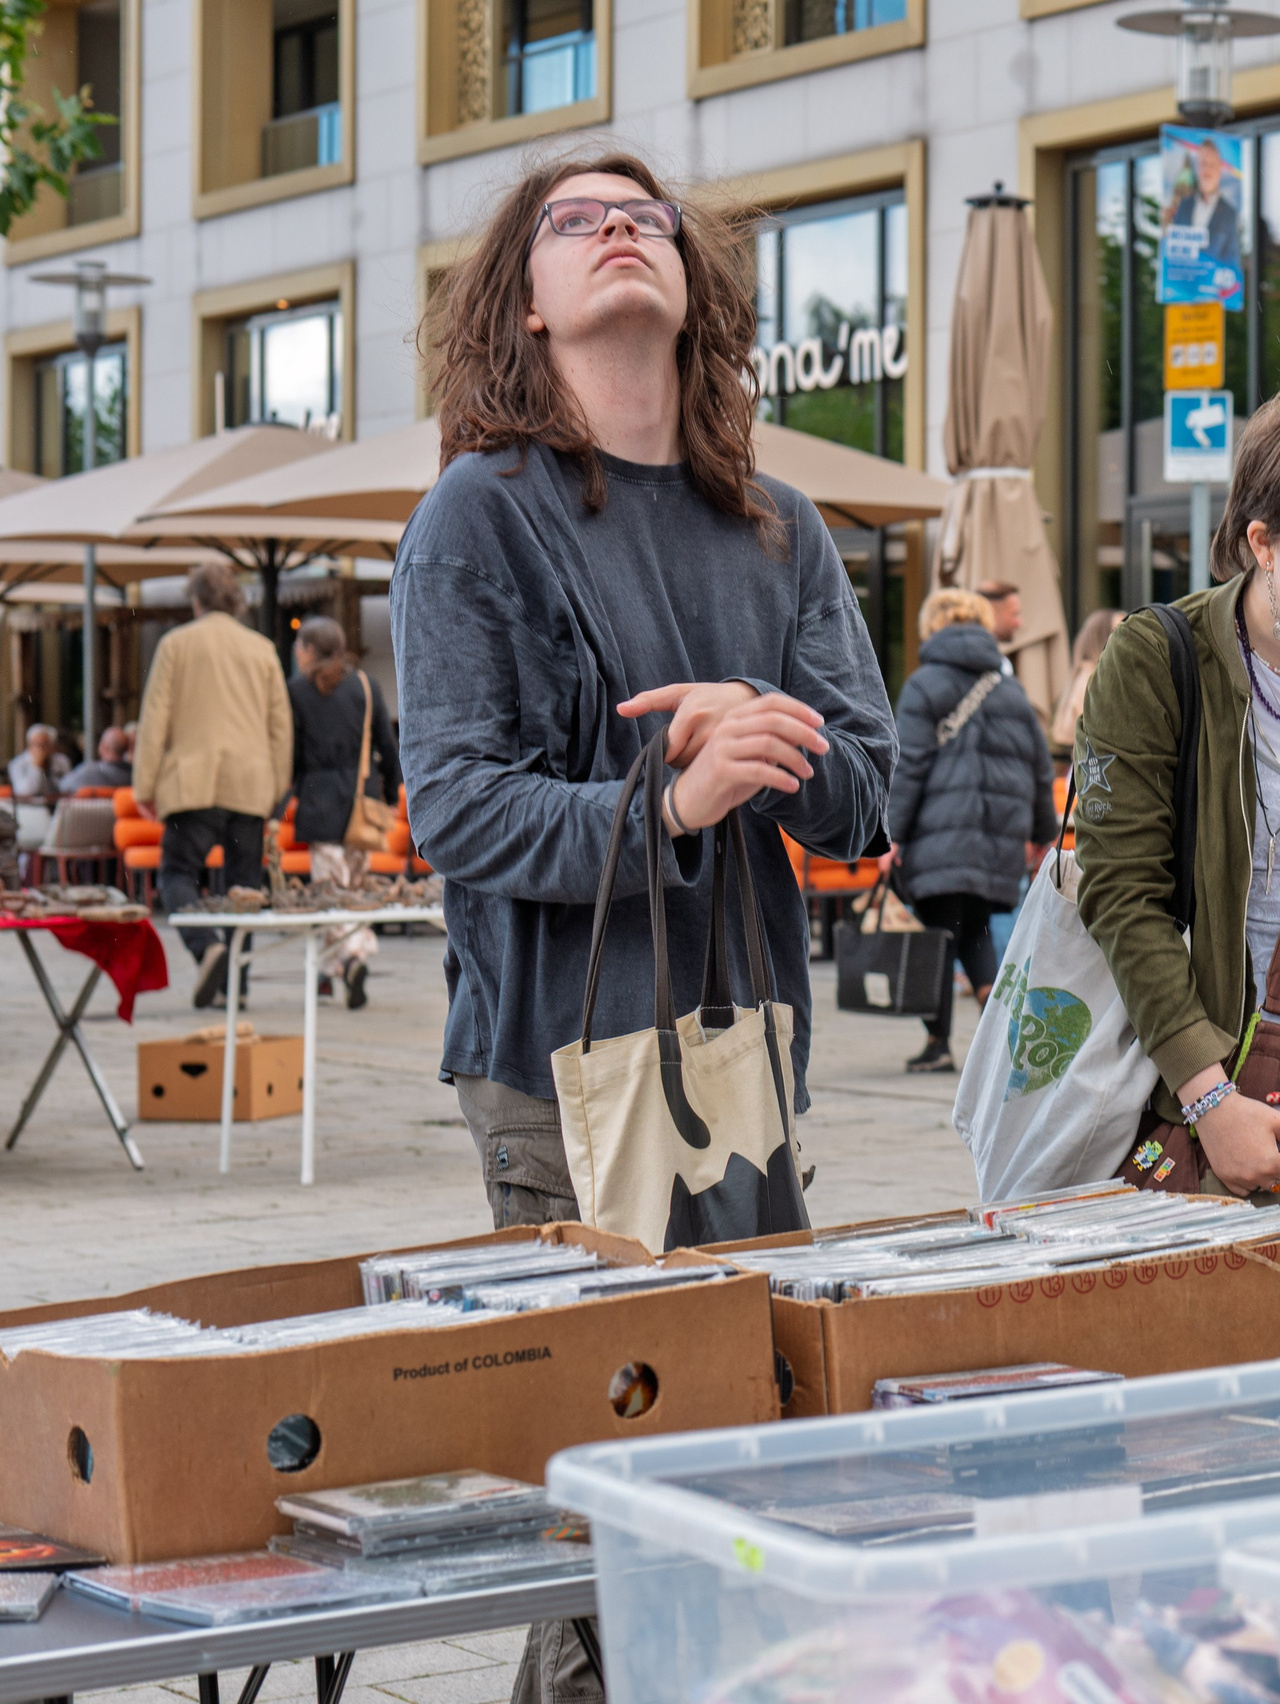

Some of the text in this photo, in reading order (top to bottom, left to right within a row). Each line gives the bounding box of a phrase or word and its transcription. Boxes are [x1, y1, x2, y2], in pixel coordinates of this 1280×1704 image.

[392, 1346, 553, 1382] Product of COLOMBIA
